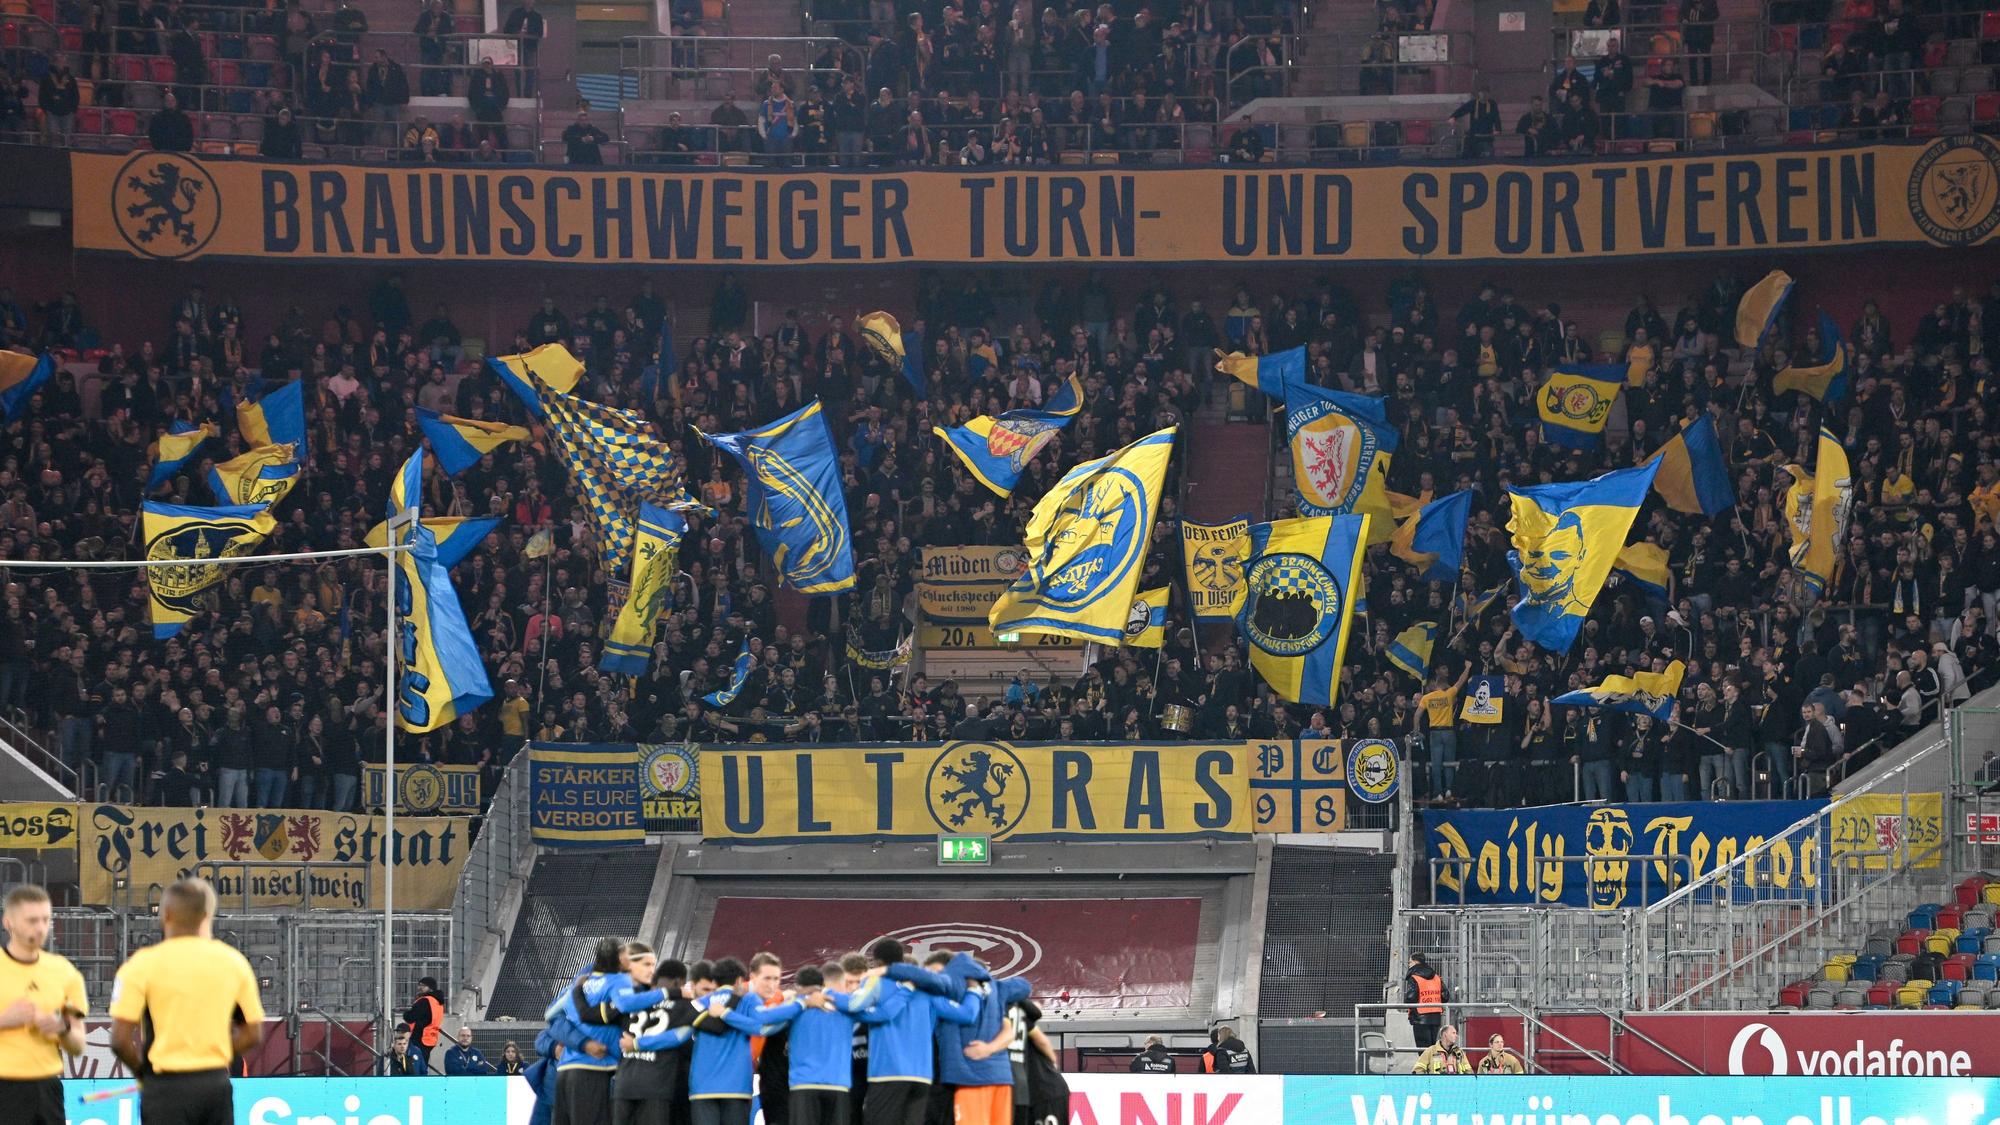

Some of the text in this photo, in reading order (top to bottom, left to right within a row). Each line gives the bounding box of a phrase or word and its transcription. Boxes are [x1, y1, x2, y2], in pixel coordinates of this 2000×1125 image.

[263, 152, 1878, 261] BRAUNSCHWEIGER TURN- UND SPORTVEREIN
[927, 555, 991, 577] Müden
[538, 764, 636, 785] STÄRKER
[538, 789, 638, 806] ALS EURE
[537, 810, 638, 827] VERBOTE
[643, 800, 701, 818] HARZ
[93, 804, 209, 873] Frei
[1435, 817, 1564, 901] Daily
[1797, 1039, 1972, 1077] vodafone
